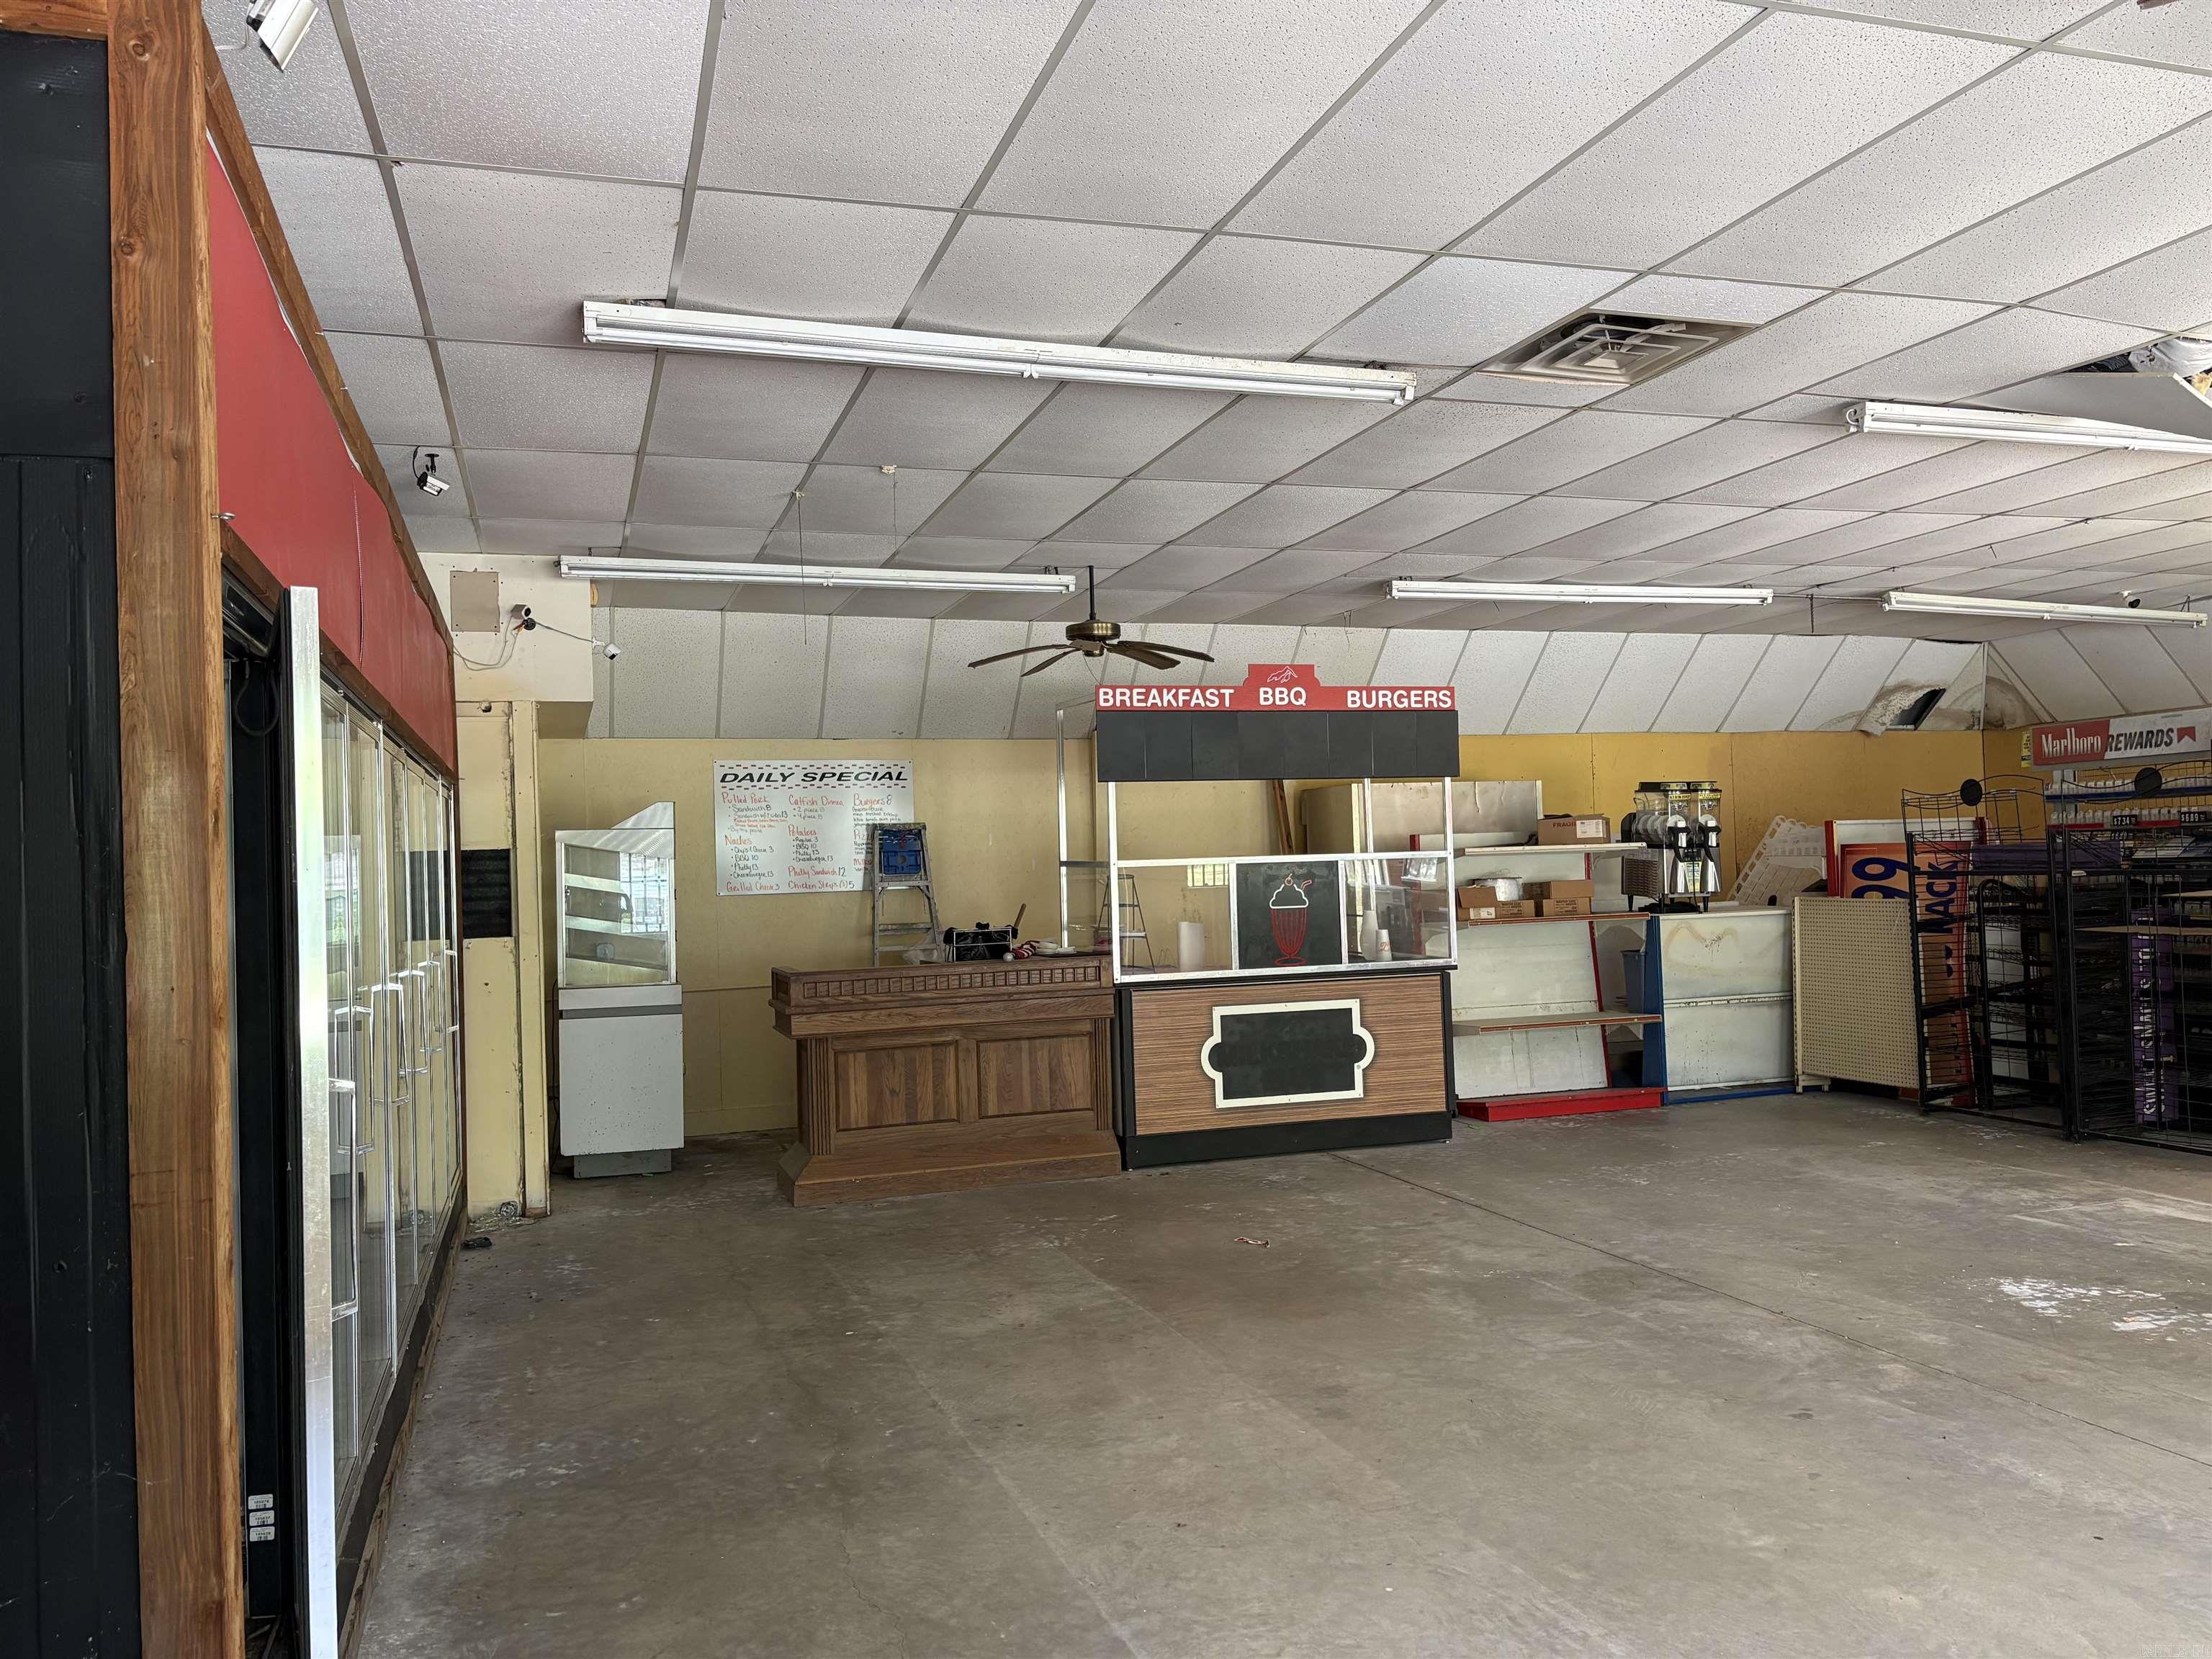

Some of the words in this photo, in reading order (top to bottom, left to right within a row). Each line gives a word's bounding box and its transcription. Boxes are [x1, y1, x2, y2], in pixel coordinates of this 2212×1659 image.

[1099, 688, 1234, 707] BREAKFAST
[1259, 687, 1306, 706] BBQ
[1346, 690, 1452, 709] BURGERS
[2041, 727, 2101, 757] Marlboro
[2107, 727, 2175, 752] REWARDS
[720, 772, 795, 783] DAILY
[801, 771, 908, 782] SPECIAL
[721, 792, 747, 804] Pulled
[789, 794, 817, 806] Catfish
[886, 793, 894, 806] 8
[732, 804, 764, 813] Sandwich
[788, 824, 817, 837] Potatoes
[853, 829, 874, 841] Pizz
[725, 835, 752, 845] Nachos
[788, 865, 810, 878] Philly
[811, 866, 837, 876] Sandwich
[838, 866, 847, 877] 12
[727, 881, 752, 892] Grilled
[788, 880, 817, 889] Chicken
[848, 881, 855, 889] 5
